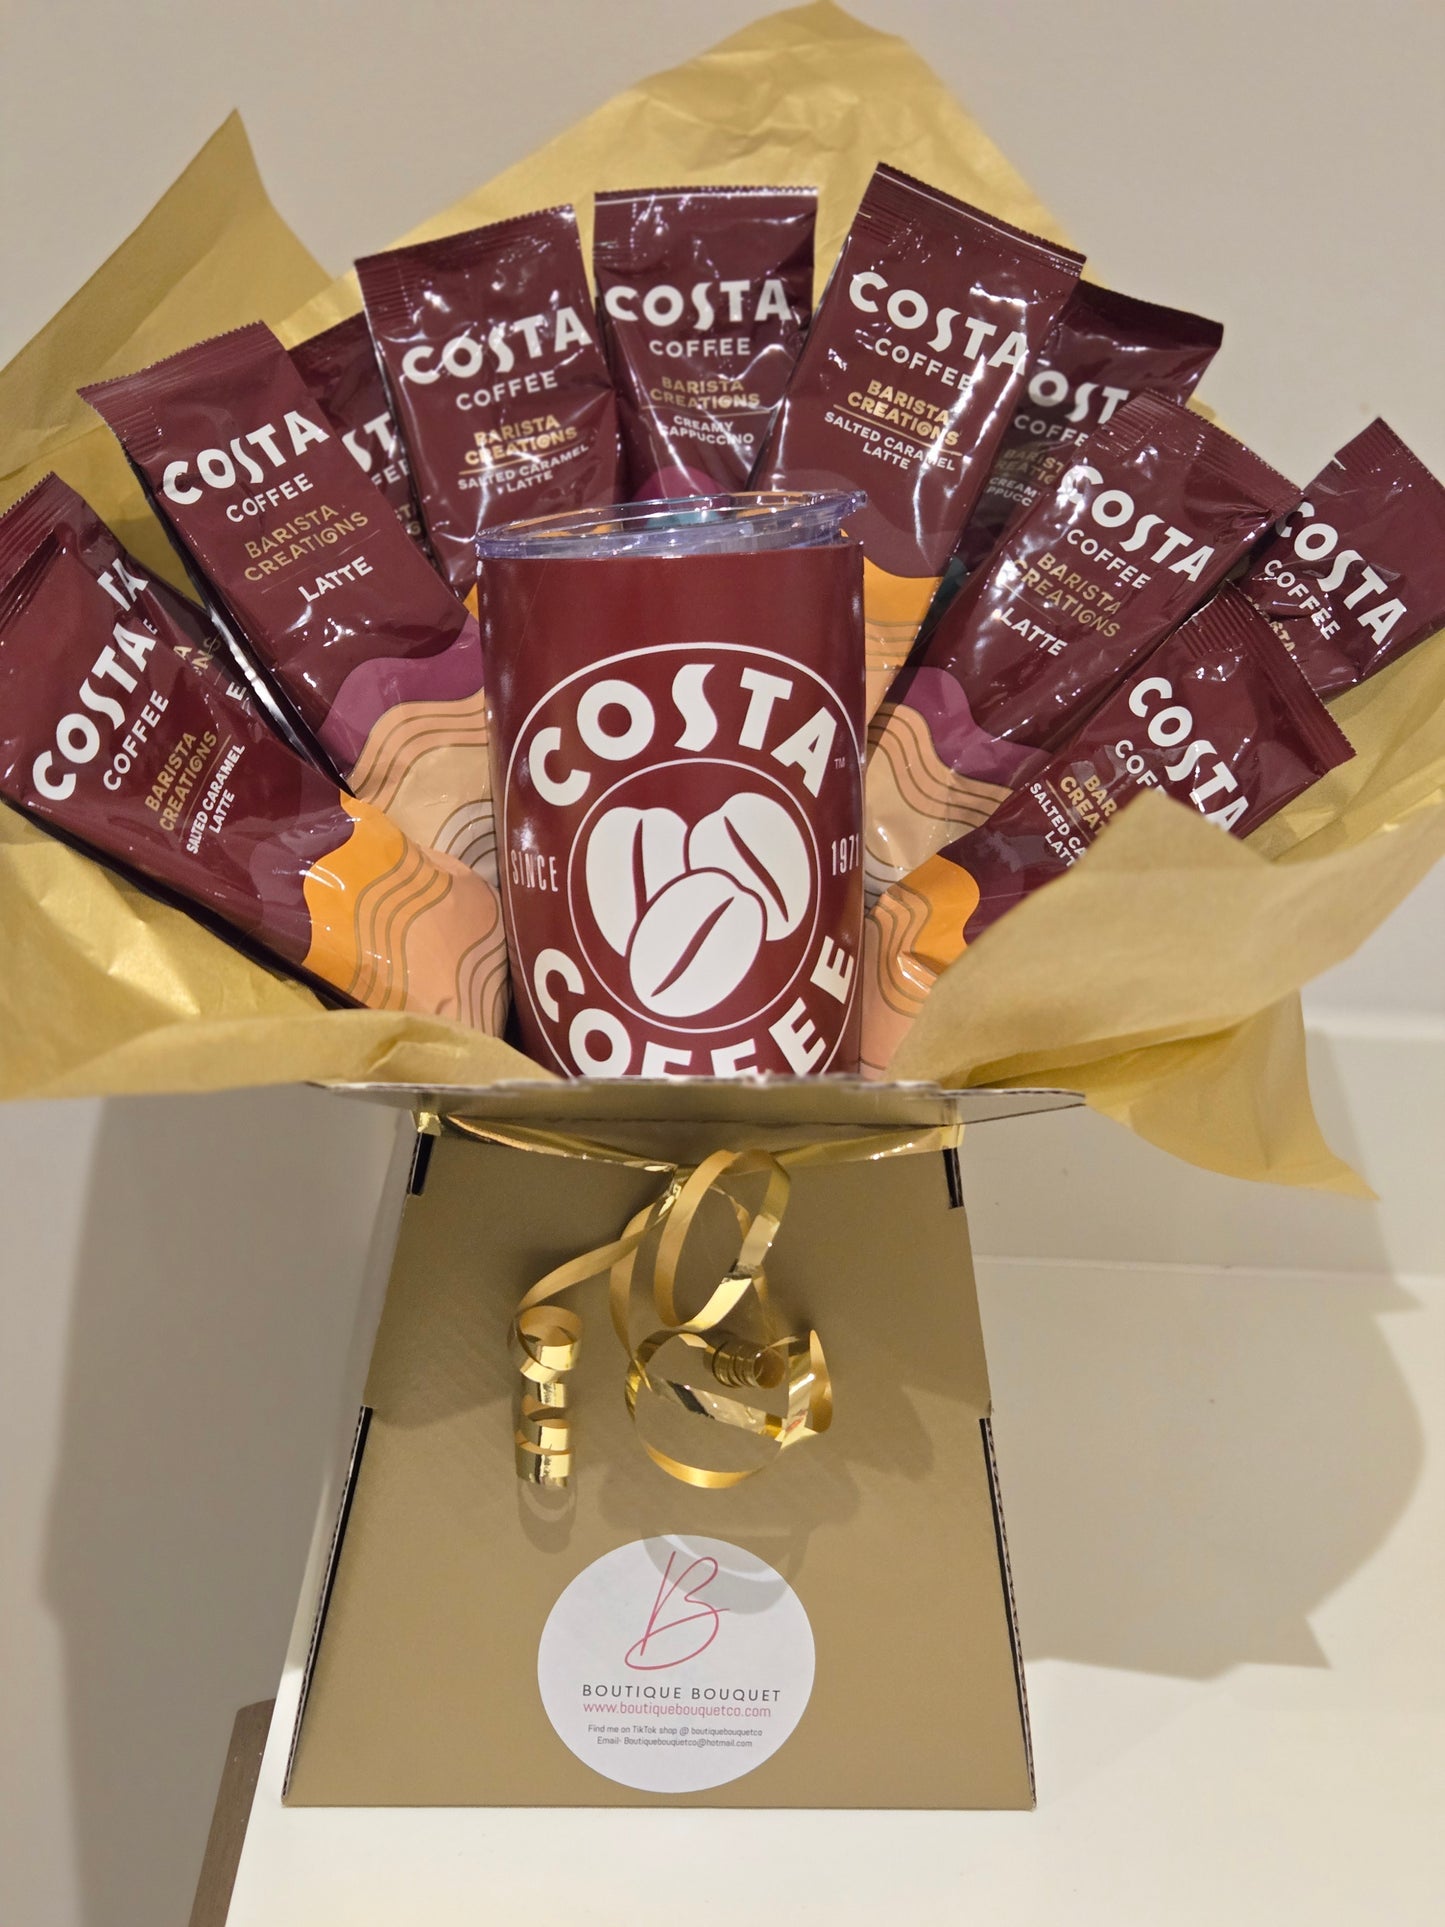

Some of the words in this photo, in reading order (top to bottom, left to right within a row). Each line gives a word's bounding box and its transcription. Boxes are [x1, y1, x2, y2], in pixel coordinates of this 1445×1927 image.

[604, 279, 792, 331] COSTA
[849, 271, 1028, 376] COSTA
[402, 306, 593, 385] COSTA
[649, 337, 750, 357] COFFEE
[875, 337, 973, 392] COFFEE
[456, 370, 558, 410] COFFEE
[650, 388, 760, 411] CREATIONS
[661, 376, 745, 394] BARISTA
[867, 379, 952, 426] BARISTA
[1028, 370, 1130, 425] OST
[473, 414, 561, 447] BARISTA
[673, 415, 734, 432] CREAMY
[824, 411, 880, 442] SALTED
[884, 436, 955, 471] CARAMEL
[847, 391, 960, 446] CREATIONS
[1014, 414, 1089, 447] COFFE
[163, 410, 330, 505] COSTA
[458, 469, 515, 490] SALTED
[519, 444, 590, 477] CARAMEL
[465, 426, 577, 465] CREATIONS
[863, 442, 911, 470] LATTE
[226, 472, 314, 523] COFFEE
[506, 470, 553, 493] LATTE
[989, 477, 1039, 498] CREAM
[243, 511, 369, 581] CREATIONS
[244, 504, 339, 559] BARISTA
[1058, 465, 1215, 583] COSTA
[298, 555, 374, 602] LATTE
[1037, 552, 1121, 615] BARISTA
[1066, 528, 1151, 590] COFFEE
[1275, 501, 1407, 646] COSTA
[1264, 559, 1341, 641] COFFEE
[1000, 607, 1068, 656] LATTE
[32, 622, 157, 801] COSTA
[528, 663, 837, 807] COSTA
[103, 689, 169, 791] COFFEE
[1128, 676, 1250, 832] COSTA
[144, 732, 197, 812] BARISTA
[159, 730, 218, 832] CREATIONS
[186, 811, 208, 854] SALTED
[202, 743, 246, 809] CARAMEL
[209, 788, 236, 834] LATTE
[1029, 782, 1070, 836] SALTED
[509, 849, 559, 892] SINCE
[831, 833, 859, 876] 1971
[534, 935, 854, 1077] COFFEE
[582, 1684, 682, 1699] BOUTIQUE
[691, 1687, 781, 1702] BOUQUET
[583, 1701, 771, 1718] www.boutiquebouquetco.com
[588, 1724, 605, 1733] Find
[632, 1725, 656, 1734] TikTok
[659, 1725, 677, 1736] shop
[691, 1728, 763, 1737] boutiquebouquetco
